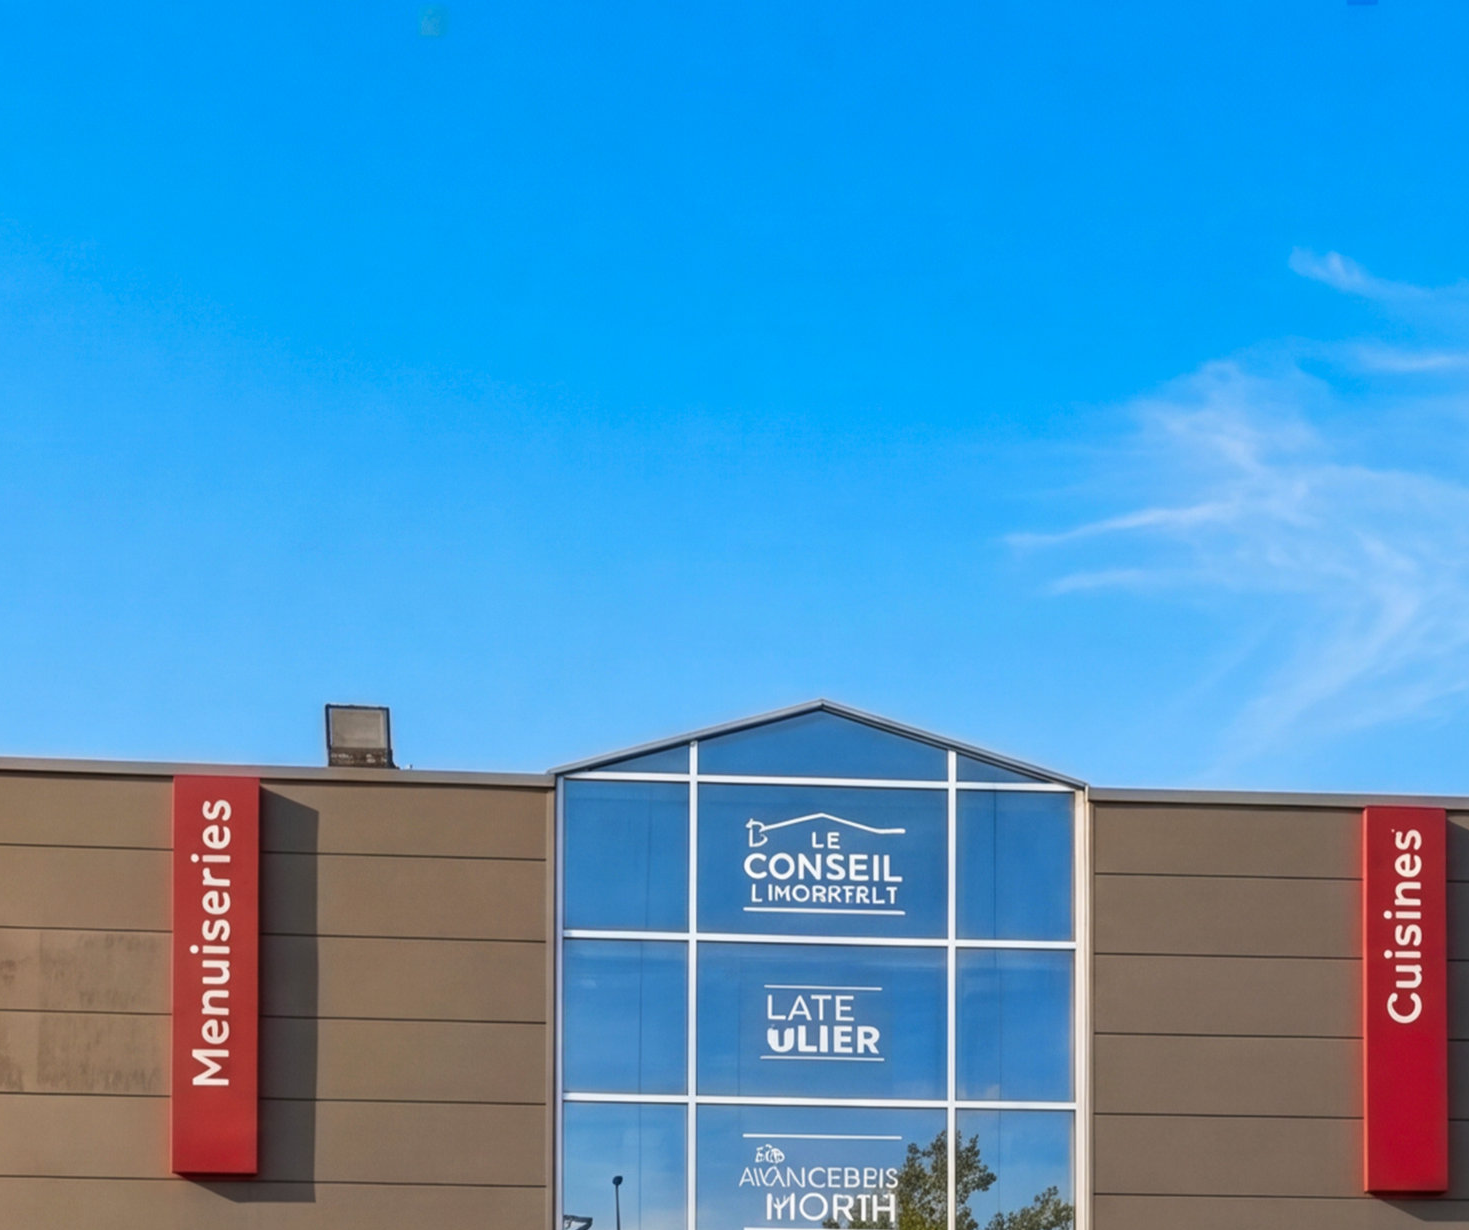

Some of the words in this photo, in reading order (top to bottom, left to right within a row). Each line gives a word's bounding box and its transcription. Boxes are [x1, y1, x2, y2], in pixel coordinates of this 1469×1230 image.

[811, 831, 841, 850] LE
[743, 852, 903, 883] CONSEIL
[1383, 828, 1423, 1024] Cuisines
[190, 799, 232, 1087] Menuiseries
[767, 994, 855, 1022] LATE
